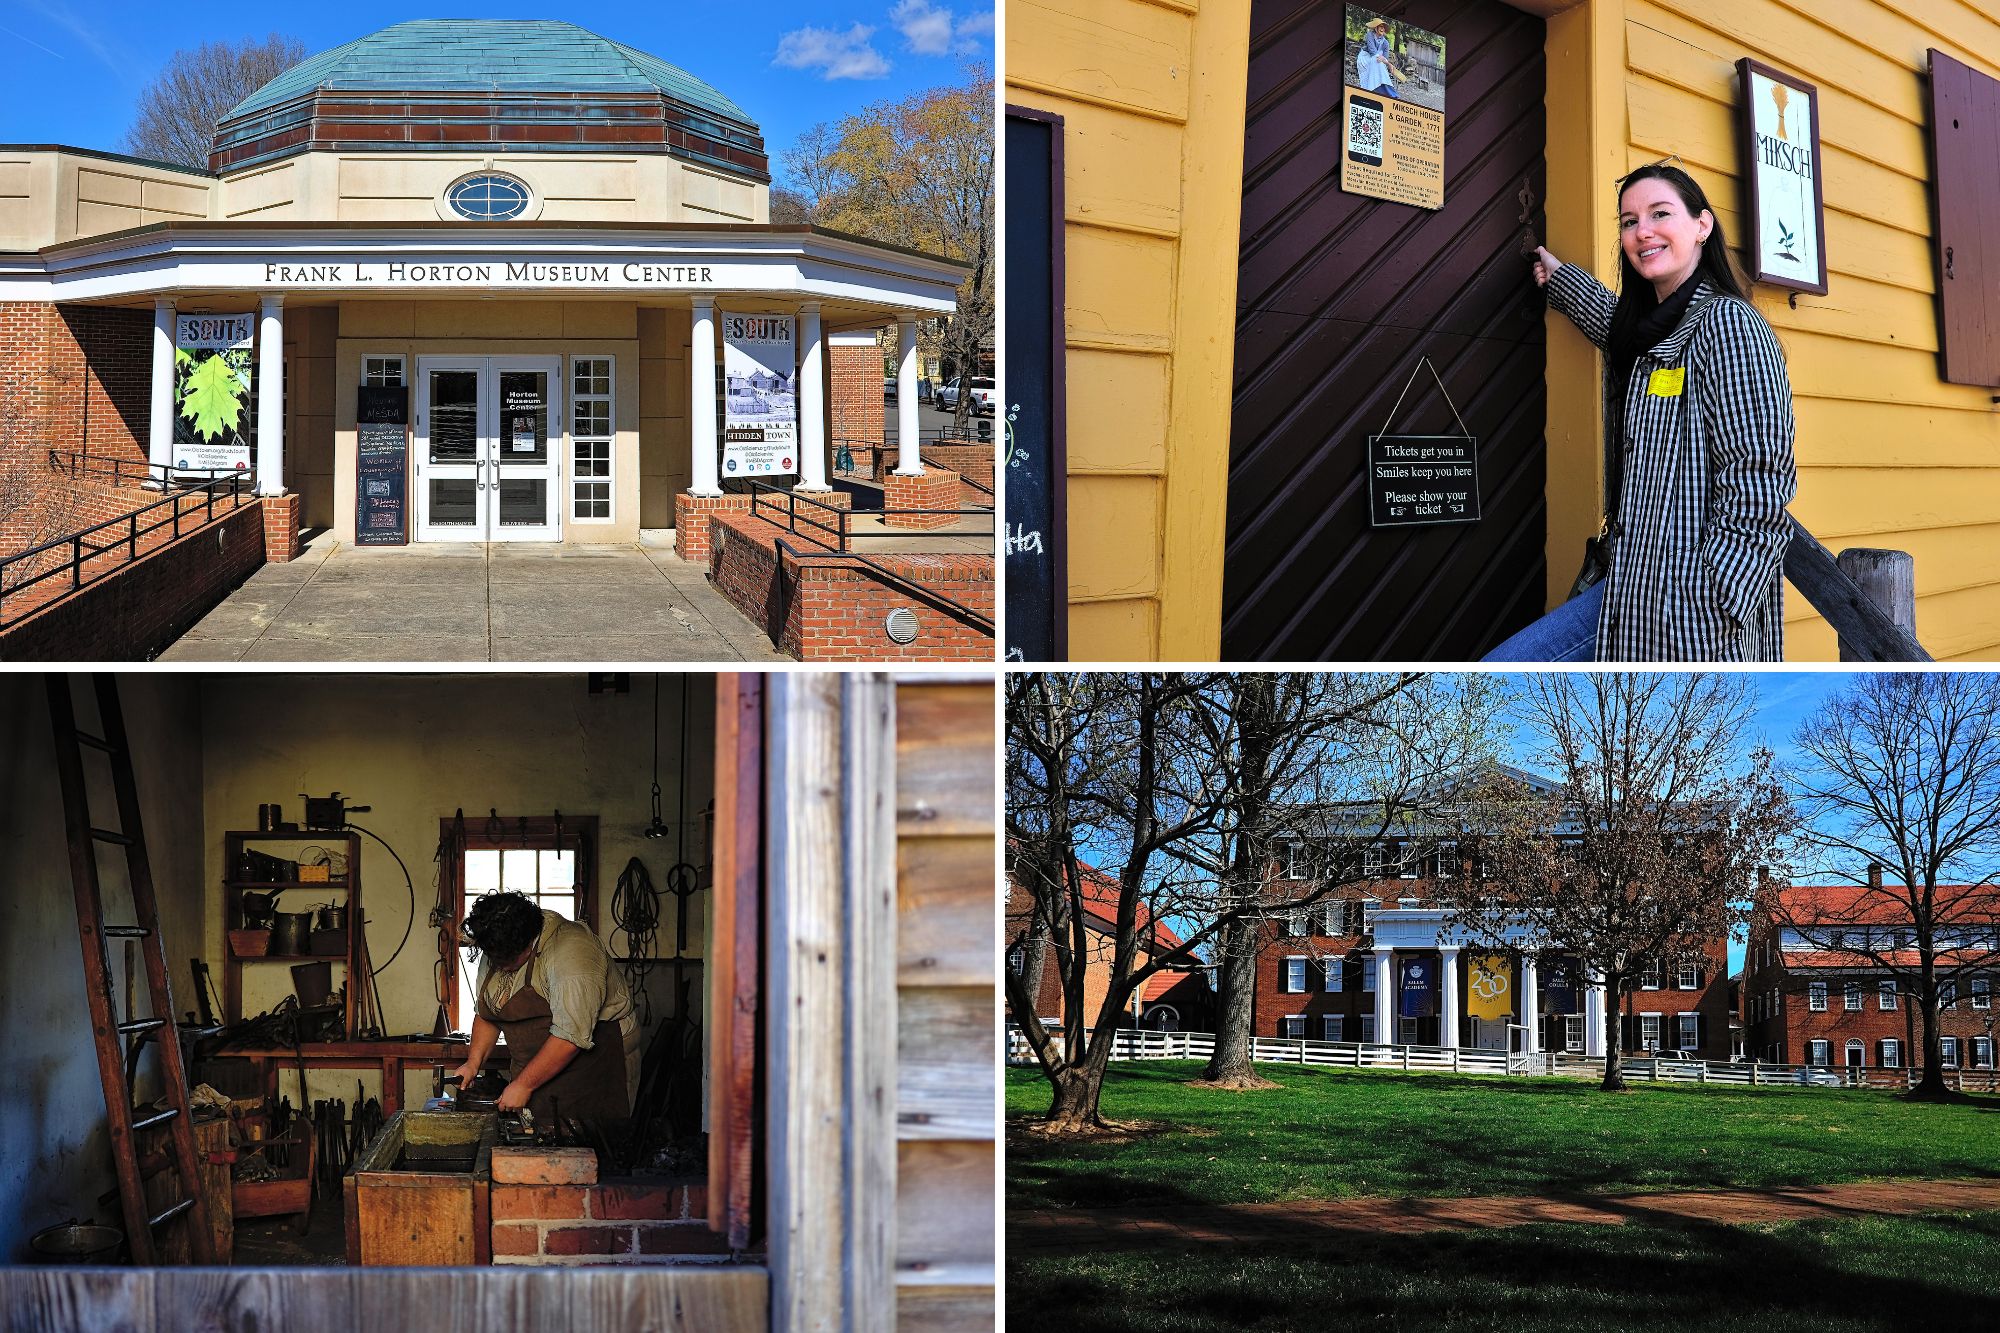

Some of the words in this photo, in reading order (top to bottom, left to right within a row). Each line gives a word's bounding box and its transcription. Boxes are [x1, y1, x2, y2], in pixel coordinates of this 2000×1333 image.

[1392, 102, 1418, 116] MIKSCH
[1420, 110, 1440, 122] HOUSE
[1388, 112, 1394, 120] &
[1426, 123, 1440, 133] 1771
[1756, 132, 1812, 180] MIKSCH
[265, 263, 342, 282] FRANK
[356, 262, 373, 282] L.
[388, 262, 490, 282] HORTON
[506, 262, 609, 282] MUSEUM
[622, 263, 712, 282] CENTER
[188, 320, 248, 342] SOUTH
[733, 318, 790, 340] SOUTH
[727, 432, 762, 440] HIDDEN
[766, 432, 791, 440] TOWN
[1384, 446, 1418, 457] Tickets
[1421, 447, 1434, 458] get
[1437, 448, 1454, 458] you
[1456, 446, 1464, 456] in
[1376, 466, 1409, 478] Smiles
[1411, 466, 1433, 479] keep
[1436, 468, 1452, 479] you
[1454, 466, 1472, 476] here
[1385, 492, 1416, 503] Please
[1420, 490, 1444, 502] show
[1446, 492, 1468, 503] your
[1415, 504, 1442, 514] ticket
[1471, 970, 1508, 998] 250
